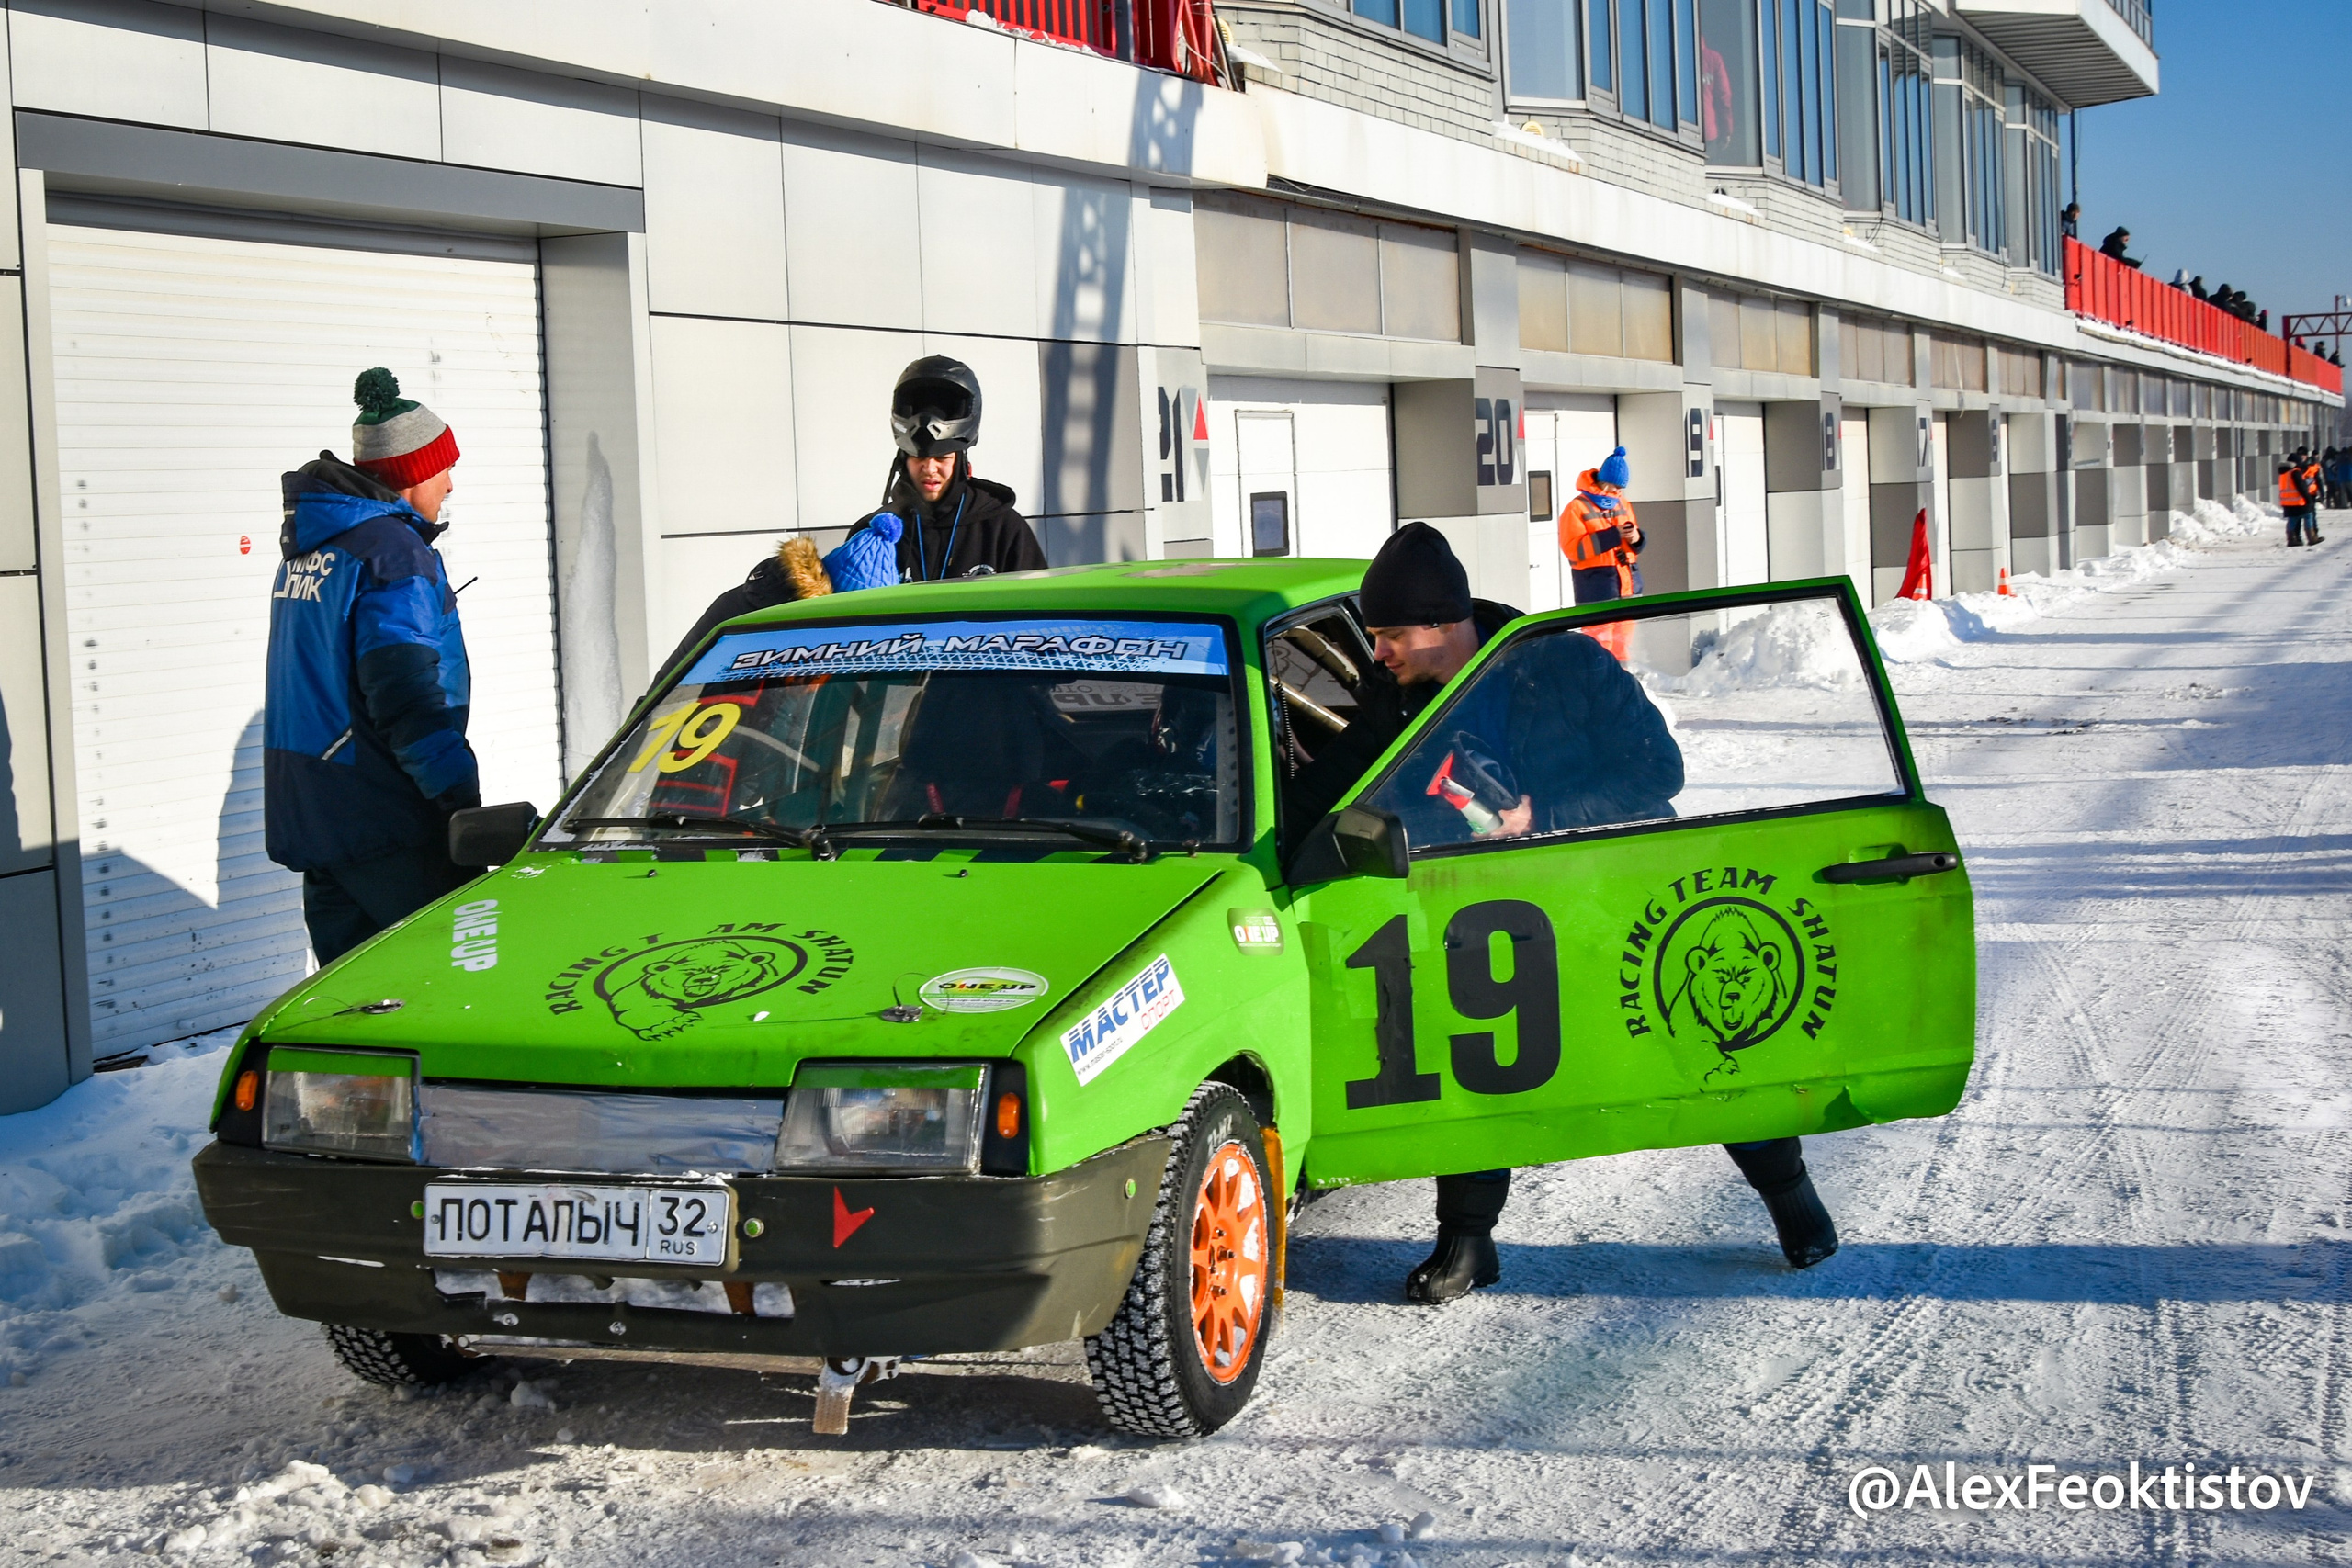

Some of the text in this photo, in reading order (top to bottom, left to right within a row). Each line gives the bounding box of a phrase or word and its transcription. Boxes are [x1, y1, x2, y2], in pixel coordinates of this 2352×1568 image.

[1475, 398, 1514, 486] 20
[731, 633, 1190, 670] ЗИМНИЙ МАРАФОН
[627, 702, 741, 773] 19
[545, 945, 629, 1016] RACING
[792, 930, 854, 995] SHATUN
[1620, 867, 1838, 1041] RACING TEAM SHATUN
[1068, 958, 1170, 1064] МАСТЕР
[1140, 989, 1177, 1031] СПОРТ
[1345, 899, 1561, 1110] 19
[439, 1196, 707, 1247] ПОТАПЫЧ 32
[660, 1239, 698, 1256] RUS
